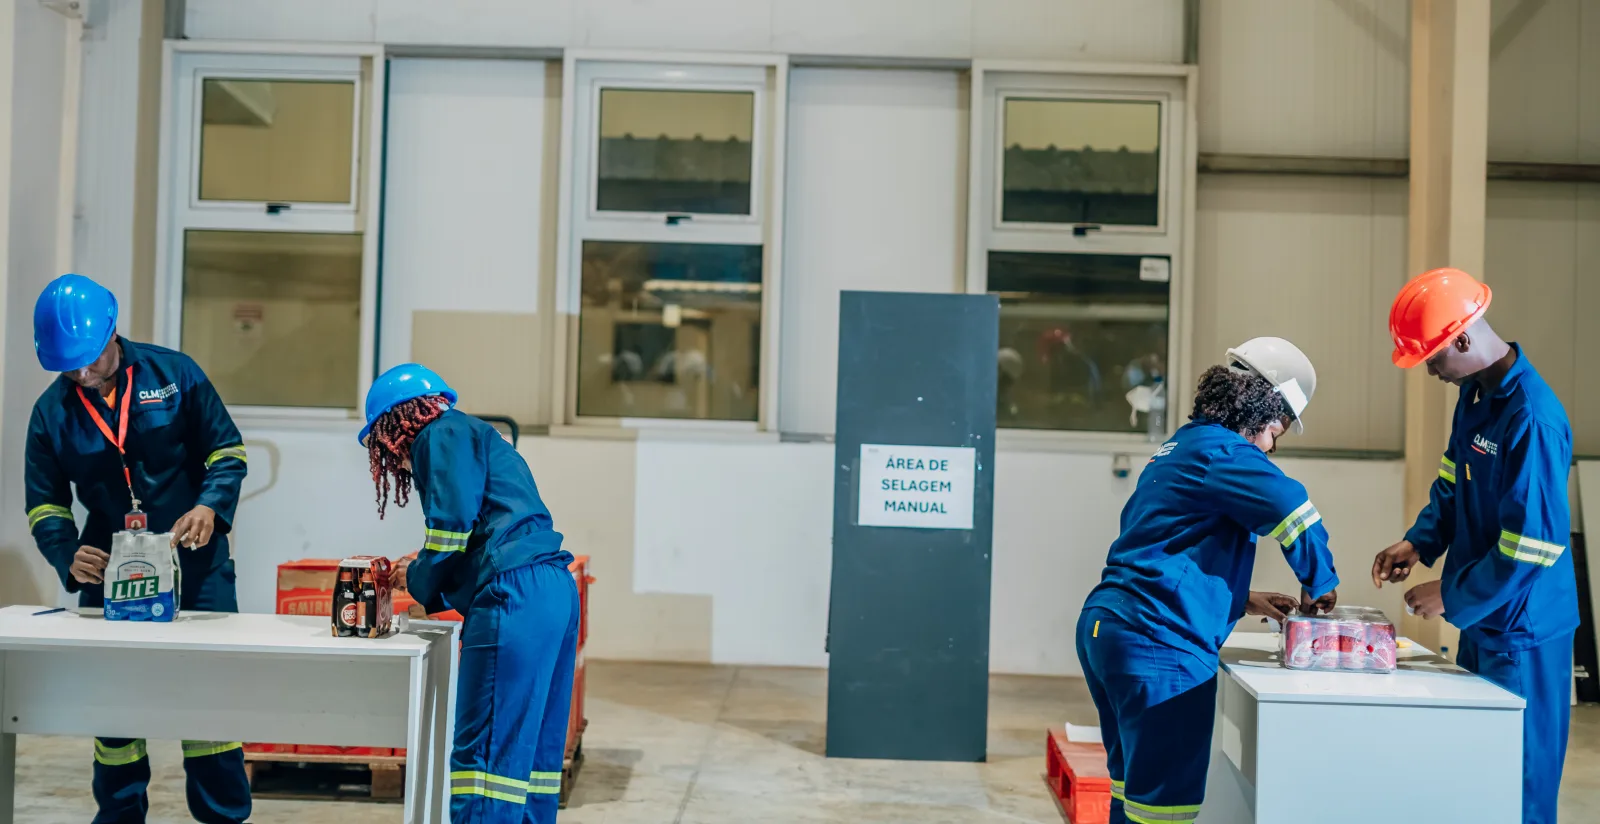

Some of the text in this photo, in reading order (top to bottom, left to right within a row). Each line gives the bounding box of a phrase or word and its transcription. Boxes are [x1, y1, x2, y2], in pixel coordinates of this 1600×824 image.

[139, 389, 160, 400] CLM
[885, 454, 949, 471] ÁREA DE
[881, 478, 951, 493] SELAGEM
[884, 500, 948, 514] MANUAL
[114, 578, 156, 600] LITE
[288, 600, 333, 615] SMIRN
